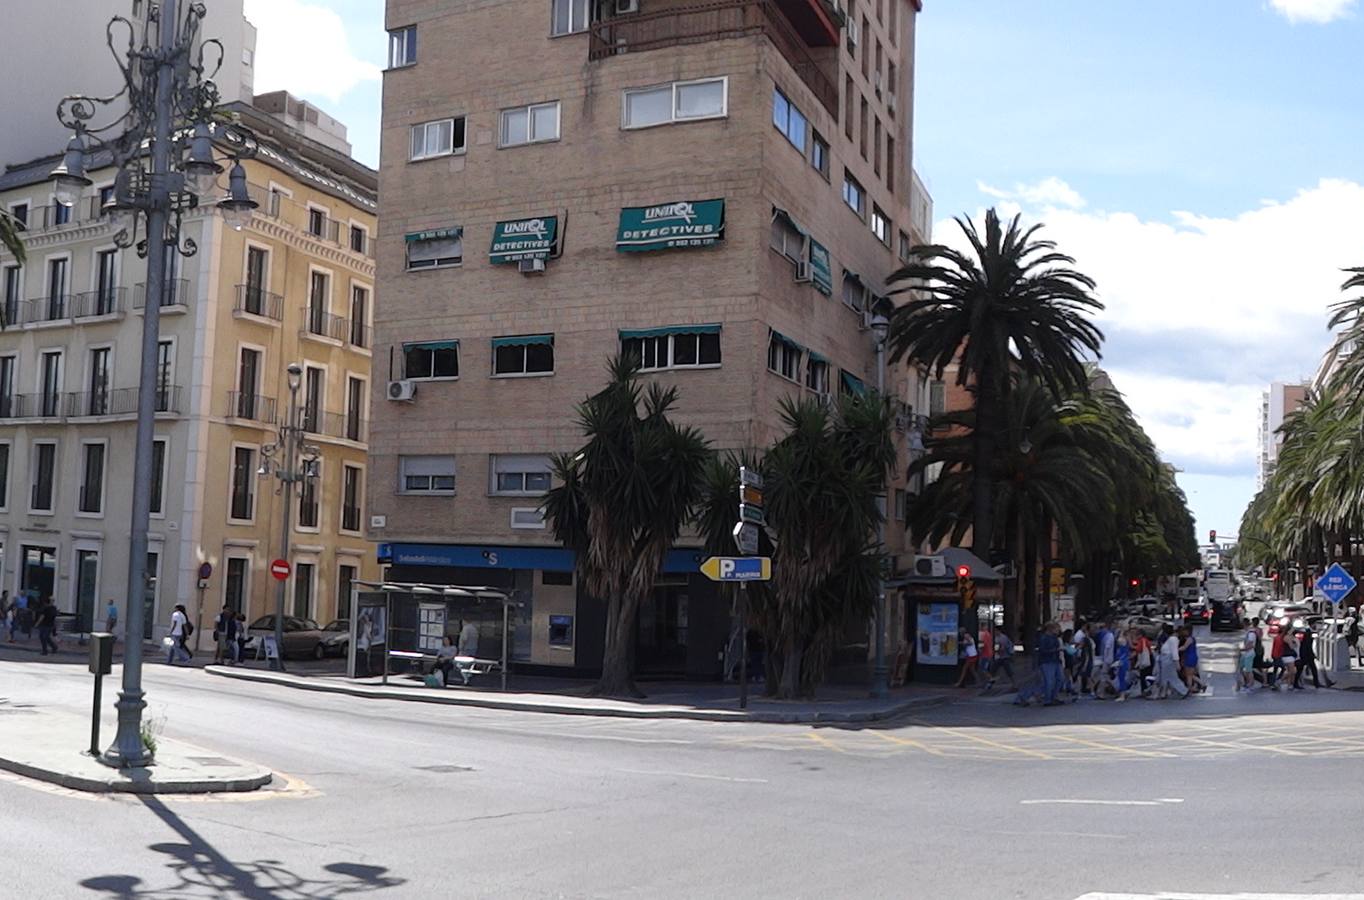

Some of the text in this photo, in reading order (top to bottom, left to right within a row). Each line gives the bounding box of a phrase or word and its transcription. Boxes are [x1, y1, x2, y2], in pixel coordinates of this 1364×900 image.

[623, 225, 713, 239] DETECTIVES
[494, 240, 550, 250] DETECTIVES
[721, 559, 735, 578] P
